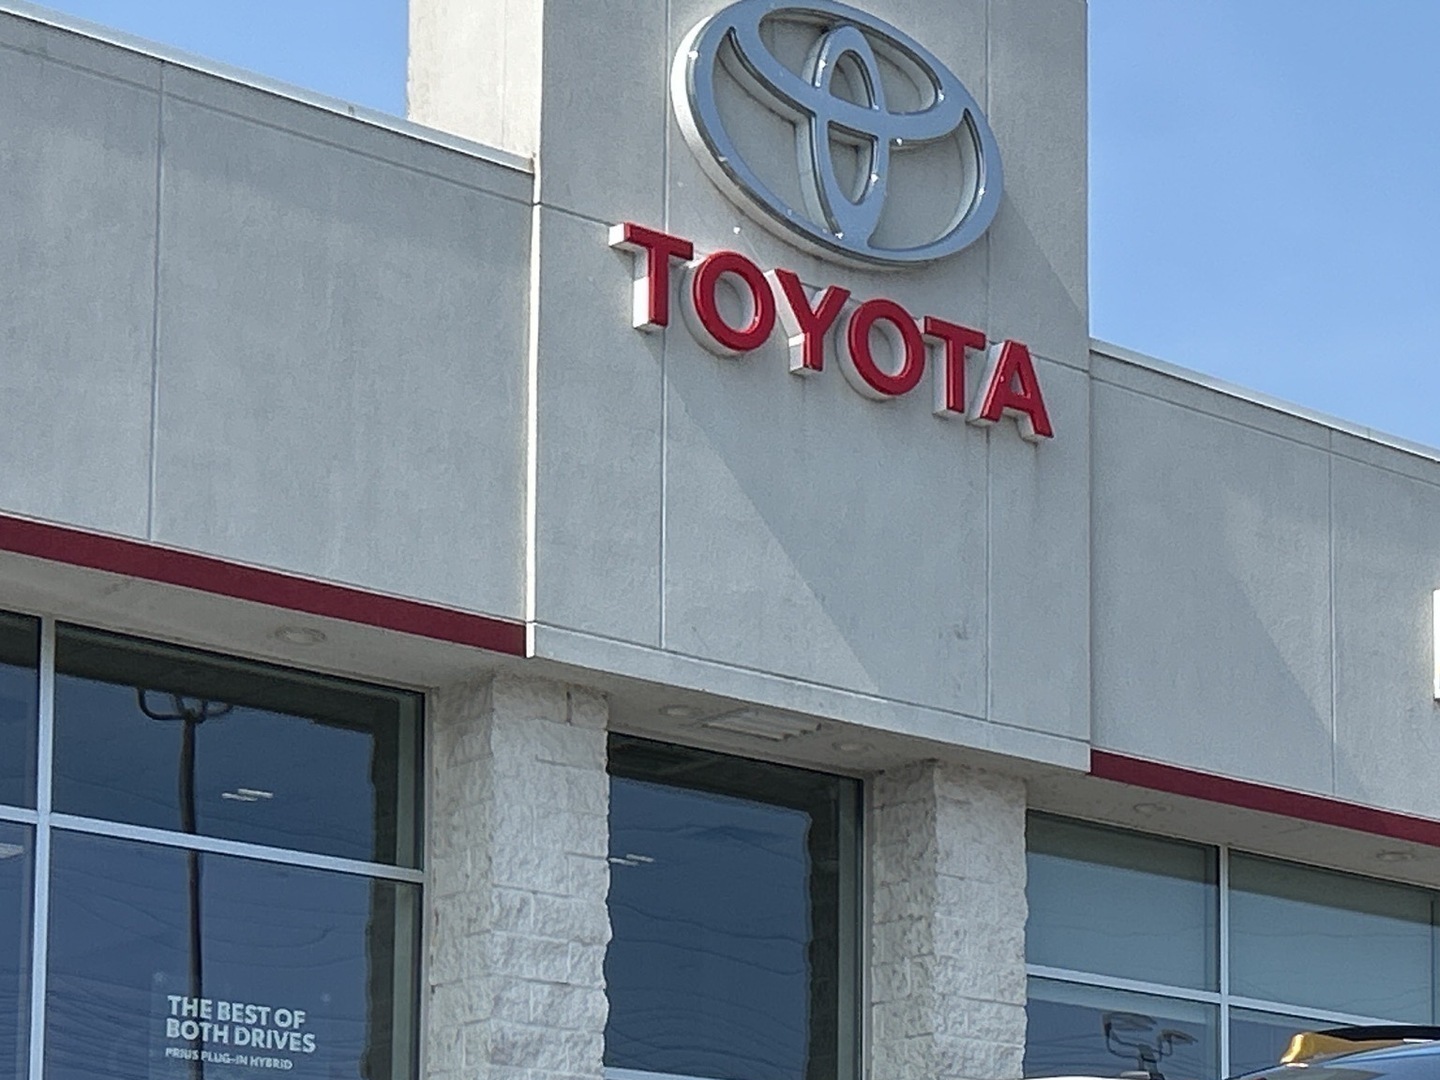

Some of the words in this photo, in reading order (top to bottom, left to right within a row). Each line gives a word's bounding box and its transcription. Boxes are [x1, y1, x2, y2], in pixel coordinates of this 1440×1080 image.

[609, 222, 1054, 441] TOYOTA
[167, 995, 212, 1020] THE
[217, 1001, 271, 1026] BEST
[274, 1008, 306, 1029] OF
[166, 1018, 229, 1044] BOTH
[234, 1025, 316, 1053] DRIVES
[200, 1049, 248, 1066] PLUG-IN
[250, 1054, 293, 1070] HYBRID
